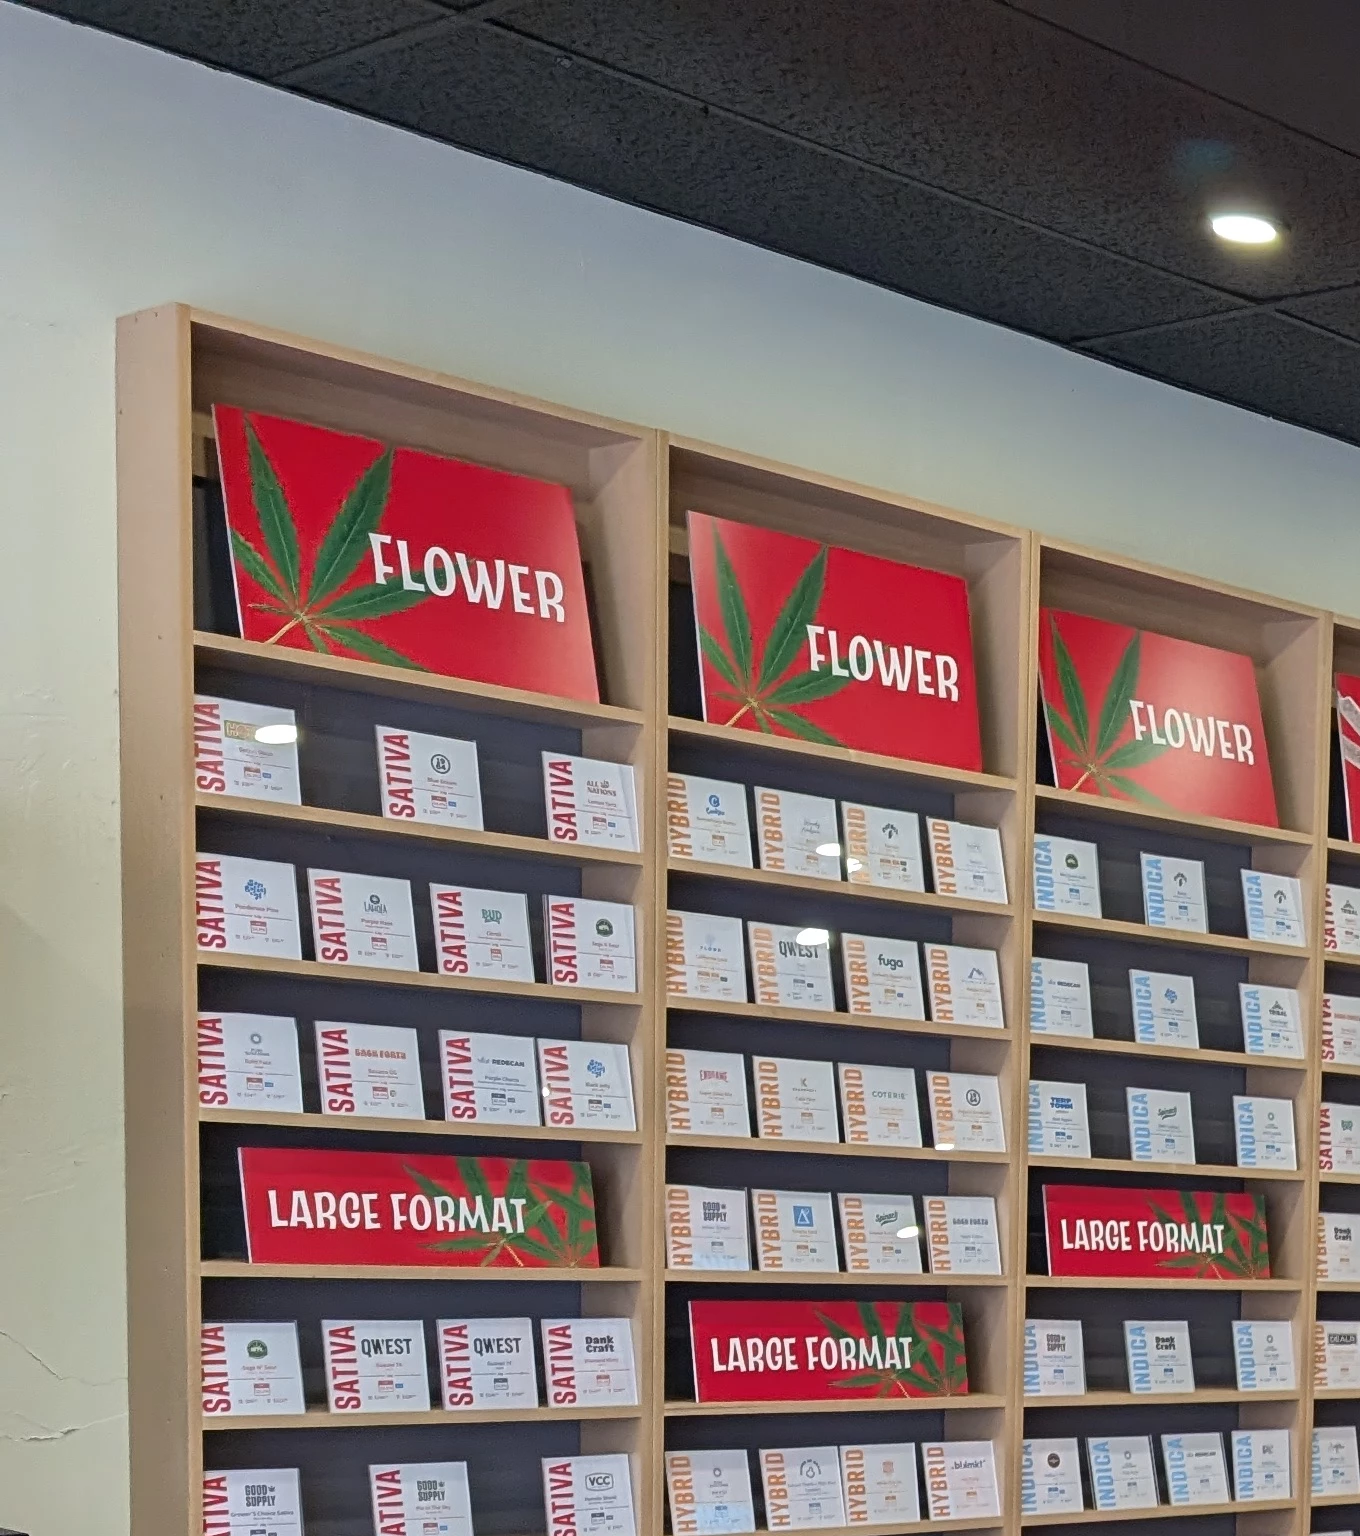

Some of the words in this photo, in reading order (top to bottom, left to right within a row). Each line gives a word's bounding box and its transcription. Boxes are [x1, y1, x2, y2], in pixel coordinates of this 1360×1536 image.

[368, 533, 565, 622] FLOWER
[806, 624, 960, 701] FLOWER
[1129, 700, 1254, 765] FLOWER
[384, 735, 414, 816] SATIVA
[549, 762, 577, 840] SATIVA
[761, 792, 784, 869] HYBRID
[317, 879, 348, 961] SATIVA
[1146, 859, 1165, 926] INDICA
[438, 893, 468, 972] SATIVA
[878, 954, 904, 969] fuga
[322, 1030, 354, 1112] SATIVA
[447, 1039, 476, 1118] SATIVA
[758, 1062, 782, 1137] HYBRID
[1128, 1094, 1151, 1159] INDICA
[267, 1190, 381, 1230] LARGE
[392, 1194, 526, 1234] FORMAT
[669, 1188, 692, 1266] HYBRID
[703, 1202, 720, 1212] GOOD
[703, 1211, 727, 1222] SUPPLY
[1061, 1219, 1133, 1252] LARGE
[1138, 1220, 1225, 1255] FORMAT
[330, 1327, 360, 1408] SATIVA
[361, 1338, 412, 1356] QWEST
[444, 1326, 473, 1405] SATIVA
[473, 1337, 521, 1355] QWEST
[585, 1344, 615, 1353] Craft
[586, 1335, 614, 1345] Dank
[709, 1337, 799, 1373] LARGE
[805, 1336, 913, 1371] FORMAT
[1130, 1325, 1151, 1391] INDICA
[244, 1484, 268, 1496] GOOD
[245, 1495, 276, 1507] SUPPLY
[417, 1480, 437, 1491] GOOD
[417, 1490, 445, 1502] SUPPLY
[588, 1475, 611, 1488] VCC
[765, 1452, 790, 1526] HYBRID
